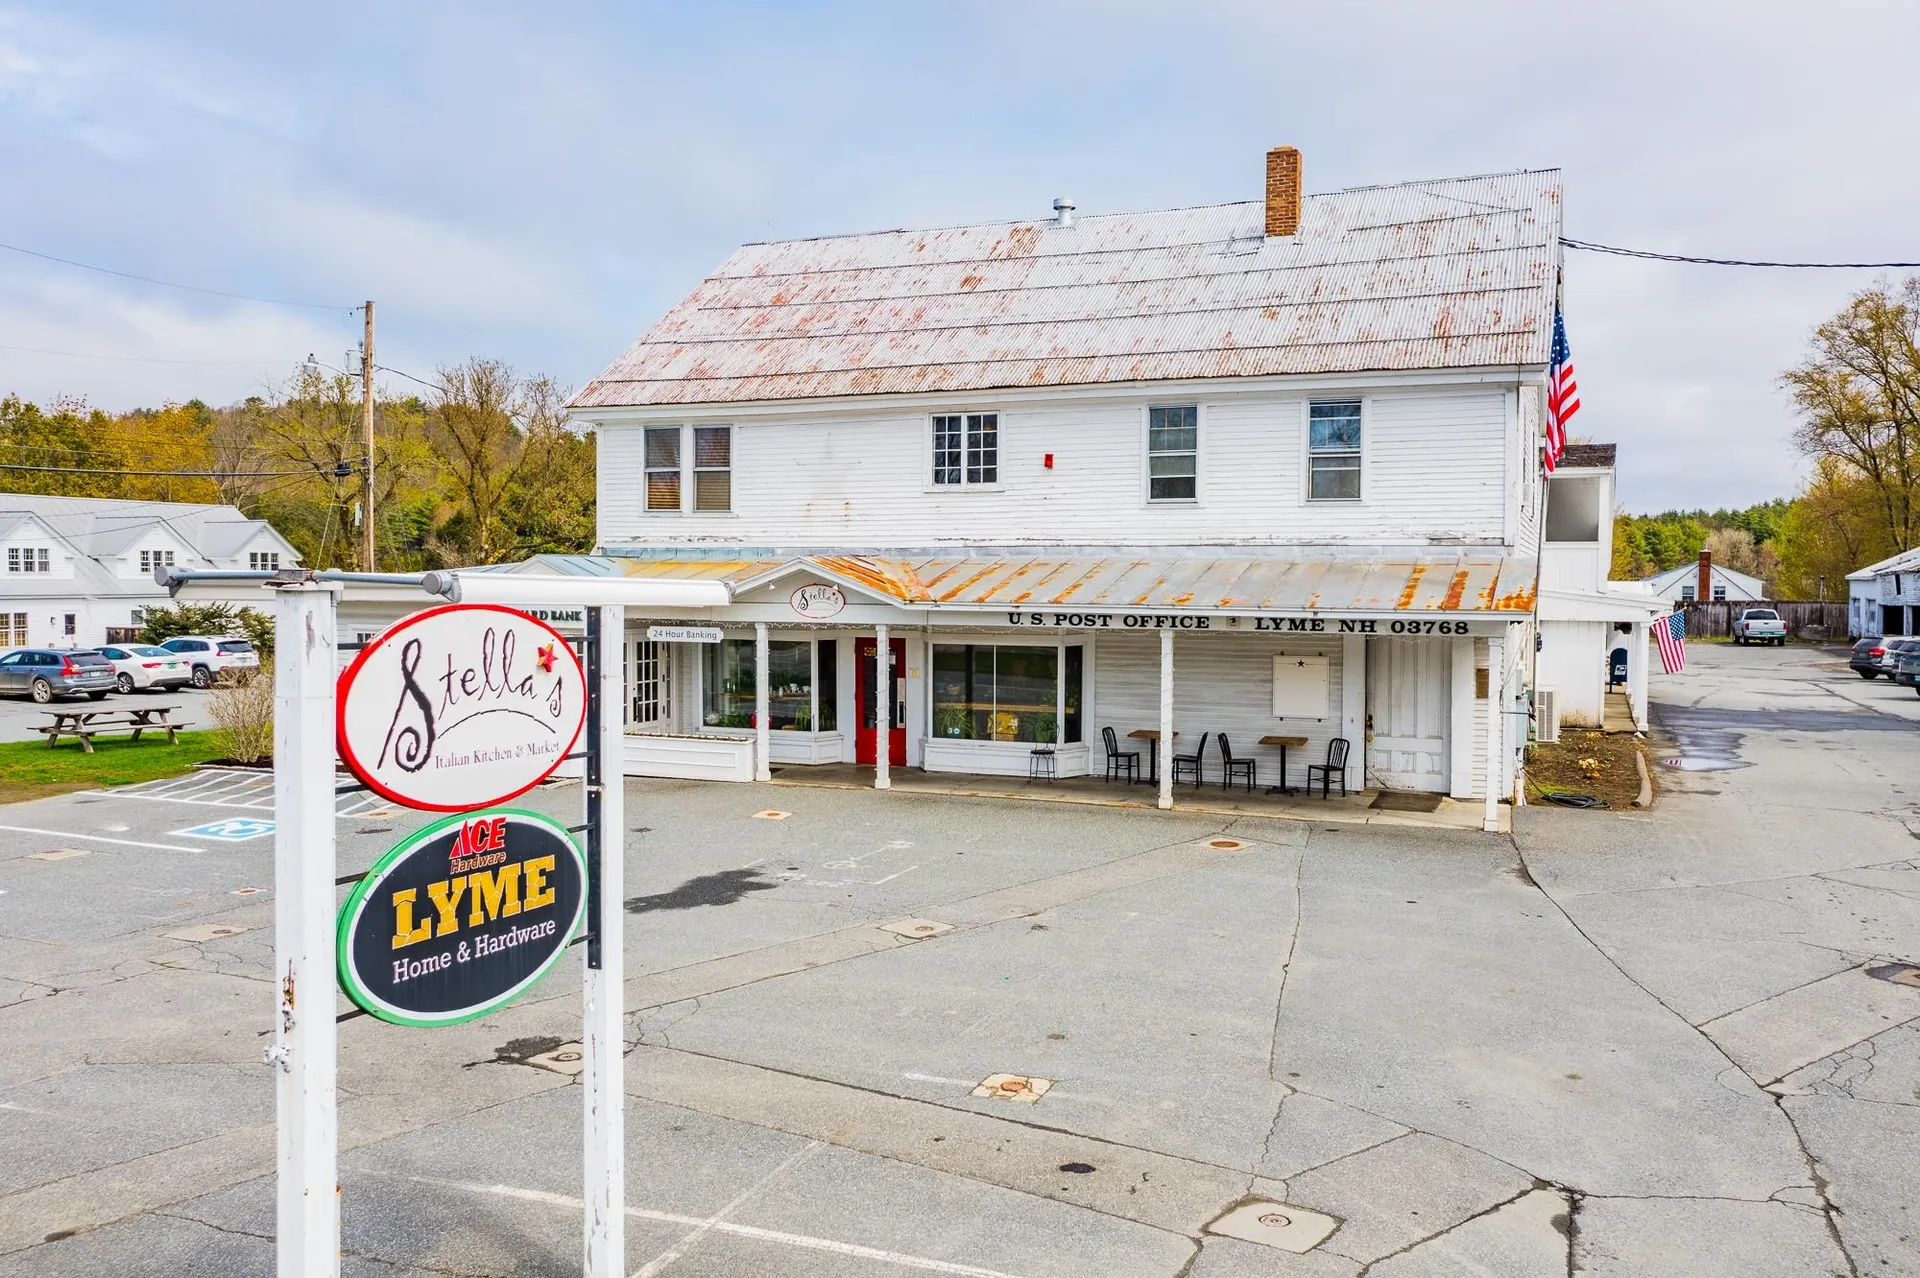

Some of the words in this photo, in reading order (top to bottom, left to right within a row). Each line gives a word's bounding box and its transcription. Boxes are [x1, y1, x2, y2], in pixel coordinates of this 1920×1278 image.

[550, 610, 583, 621] BANK
[1054, 613, 1112, 627] POST
[1123, 615, 1210, 629] OFFICE
[1254, 617, 1325, 631] LYME
[1338, 619, 1377, 633] NH
[1390, 620, 1469, 635] 03768
[653, 630, 663, 638] 24
[666, 630, 684, 638] Hour
[687, 631, 717, 640] Banking
[377, 627, 563, 773] Stella's
[435, 752, 470, 769] Italian
[474, 746, 512, 763] Kitchen
[516, 745, 524, 758] &
[527, 740, 559, 756] Market
[449, 817, 507, 859] ACE
[450, 851, 507, 874] Hardware
[392, 855, 555, 950] LYME
[392, 951, 452, 984] Home
[456, 941, 471, 963] &
[474, 920, 556, 958] Hardware
